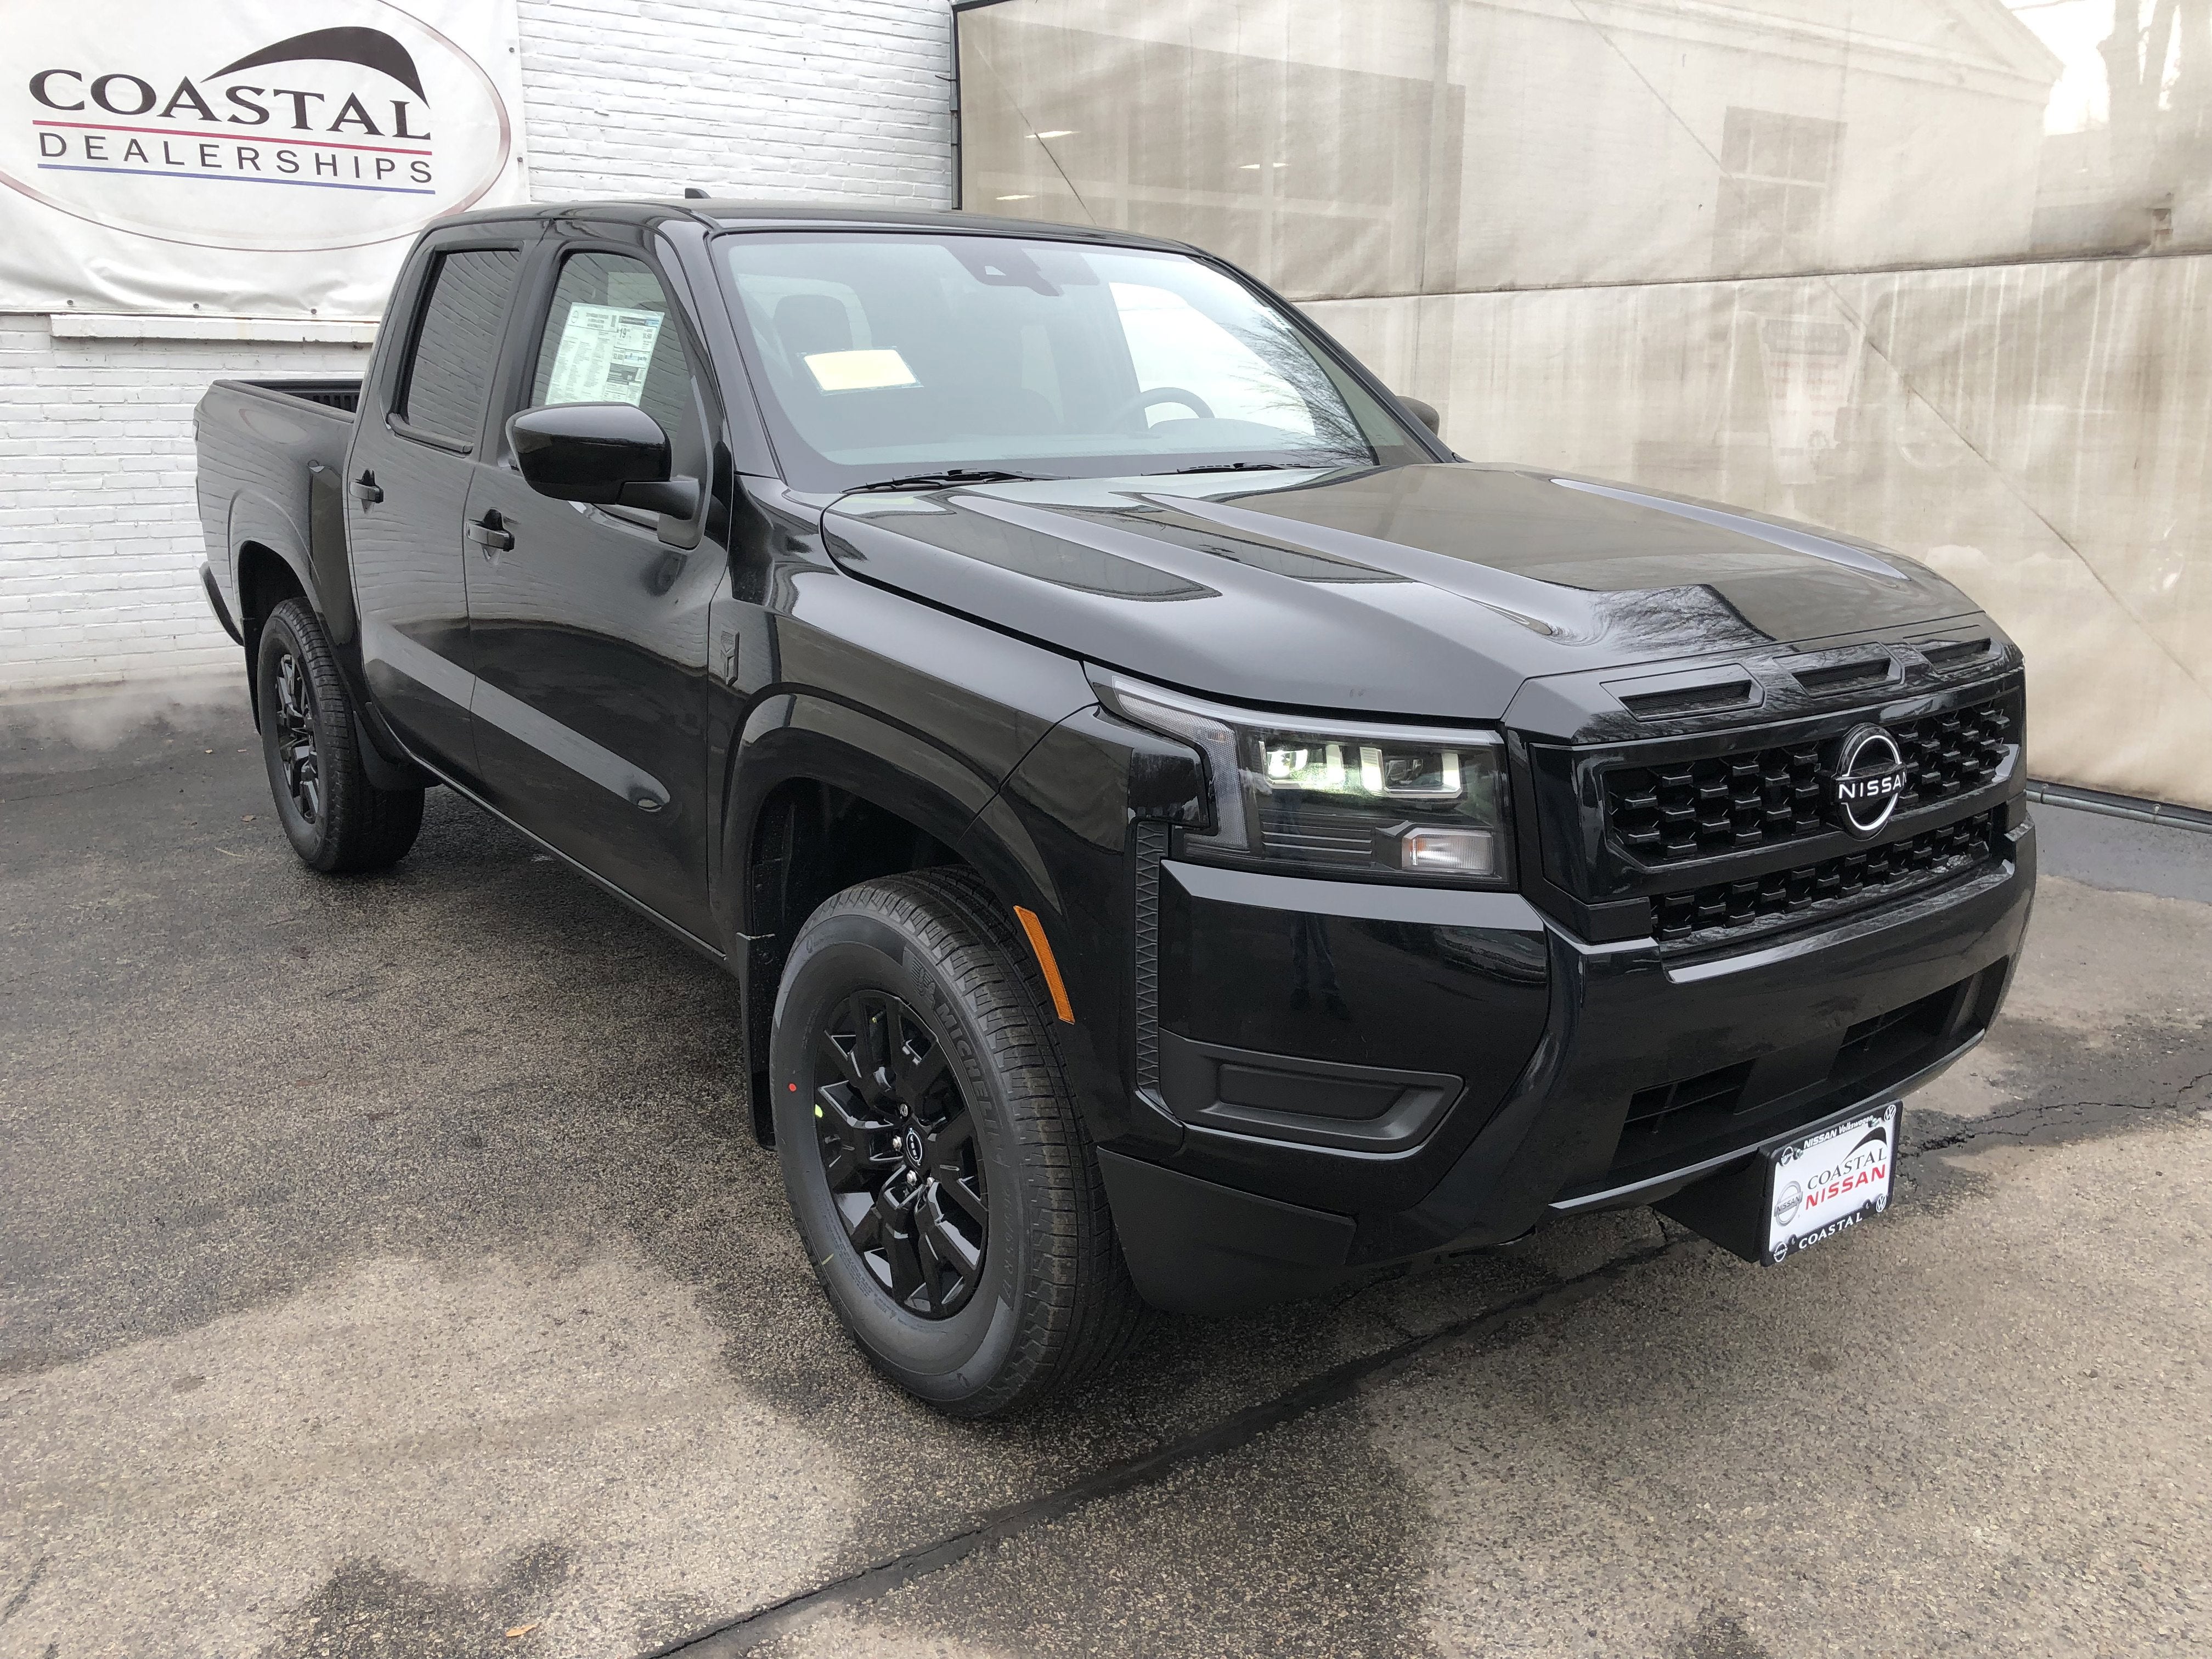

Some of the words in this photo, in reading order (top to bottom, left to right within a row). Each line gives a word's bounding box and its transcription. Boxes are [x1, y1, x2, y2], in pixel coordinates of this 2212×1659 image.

[29, 69, 431, 140] COASTAL
[39, 132, 433, 183] DEALERSHIPS
[1839, 771, 1907, 799] NISSAN
[1803, 1128, 1837, 1149] NISSAN
[1838, 1115, 1874, 1134] Volkswagen
[1805, 1164, 1886, 1210] NISSAN
[1807, 1147, 1887, 1189] COASTAL
[1776, 1195, 1801, 1213] NISSAN
[1798, 1212, 1863, 1249] COASTAL
